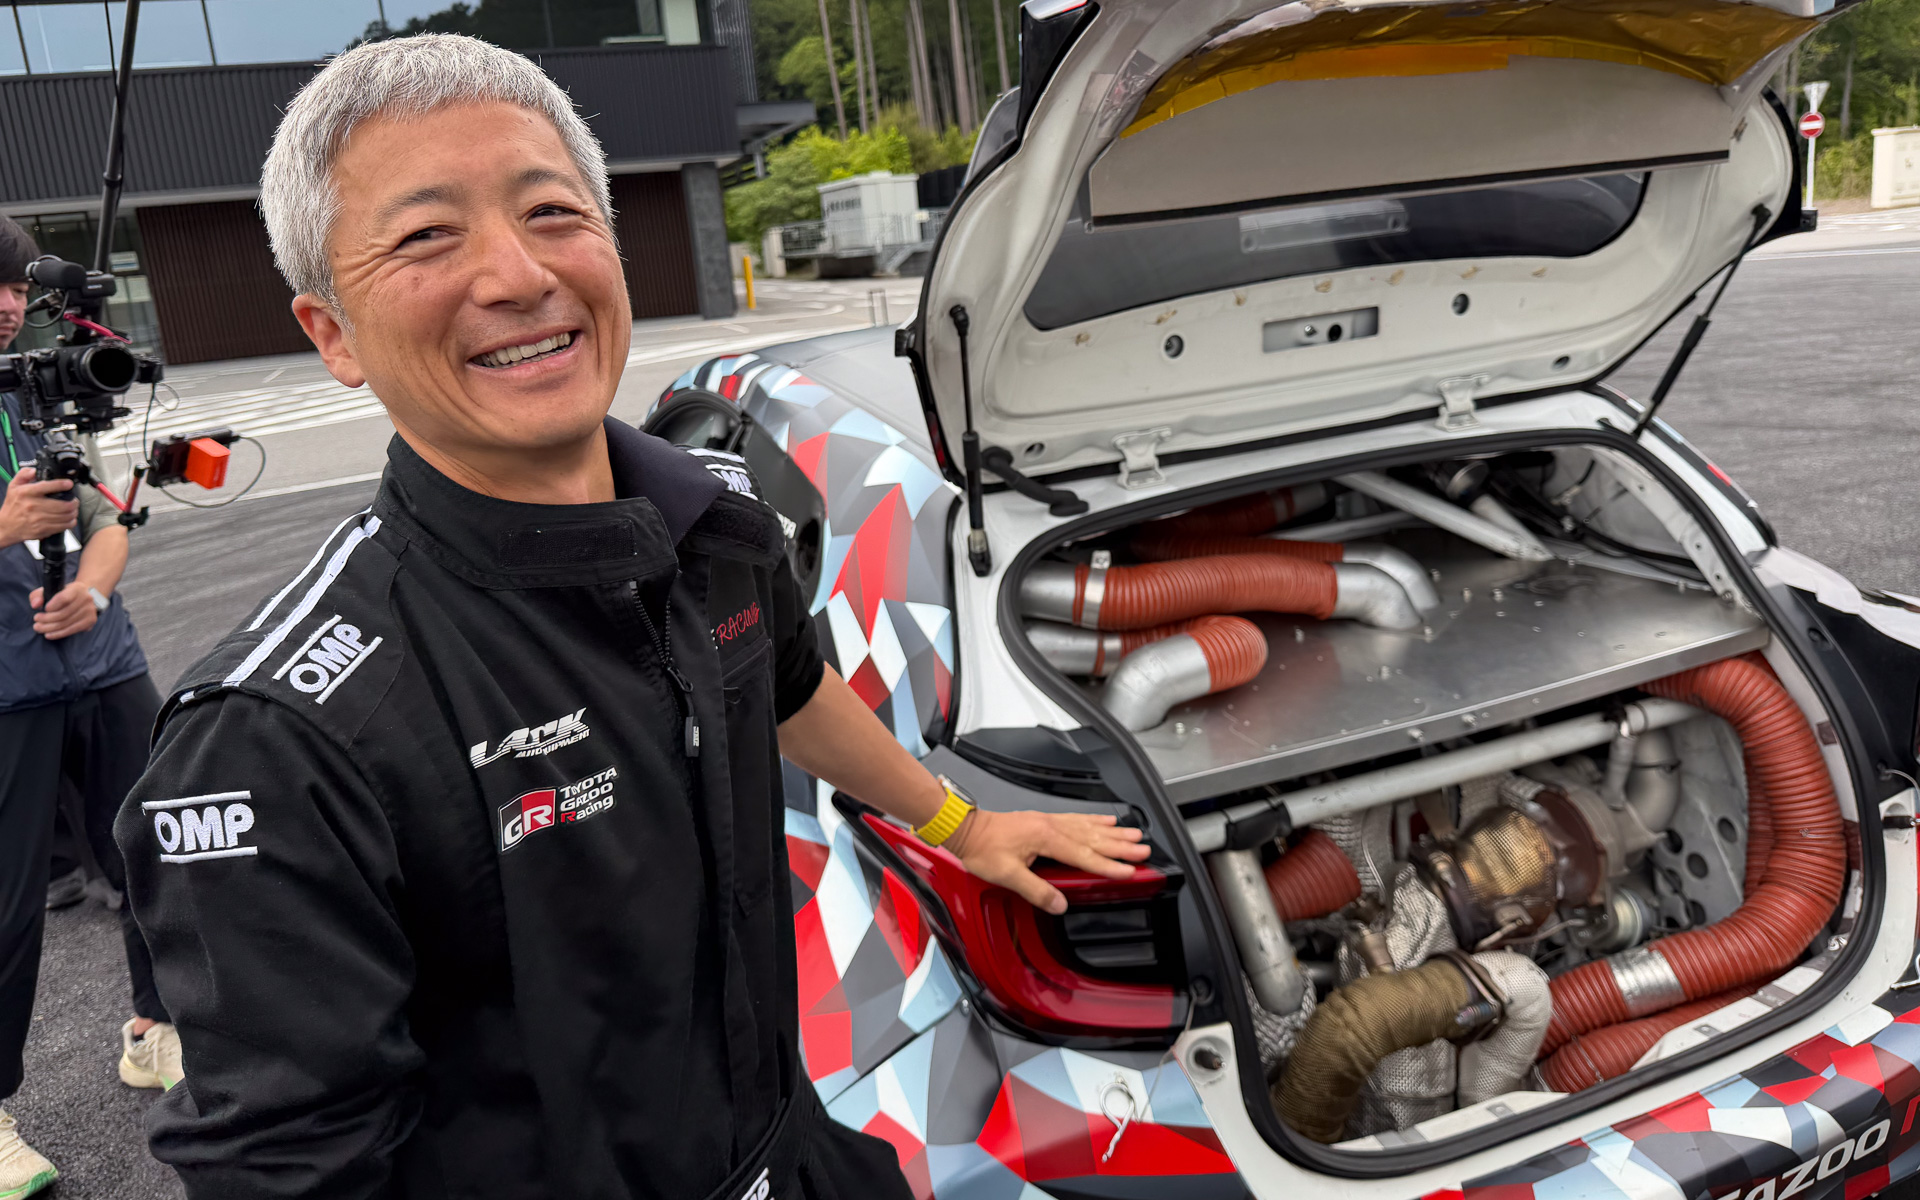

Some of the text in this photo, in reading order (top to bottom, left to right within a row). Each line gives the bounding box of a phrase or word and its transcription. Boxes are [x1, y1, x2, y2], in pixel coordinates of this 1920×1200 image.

[710, 470, 753, 493] MP
[289, 623, 366, 694] OMP
[560, 767, 618, 799] TOYOTA
[560, 782, 614, 812] GAZOO
[504, 804, 553, 845] GR
[560, 795, 614, 823] Racing
[154, 803, 255, 853] OMP
